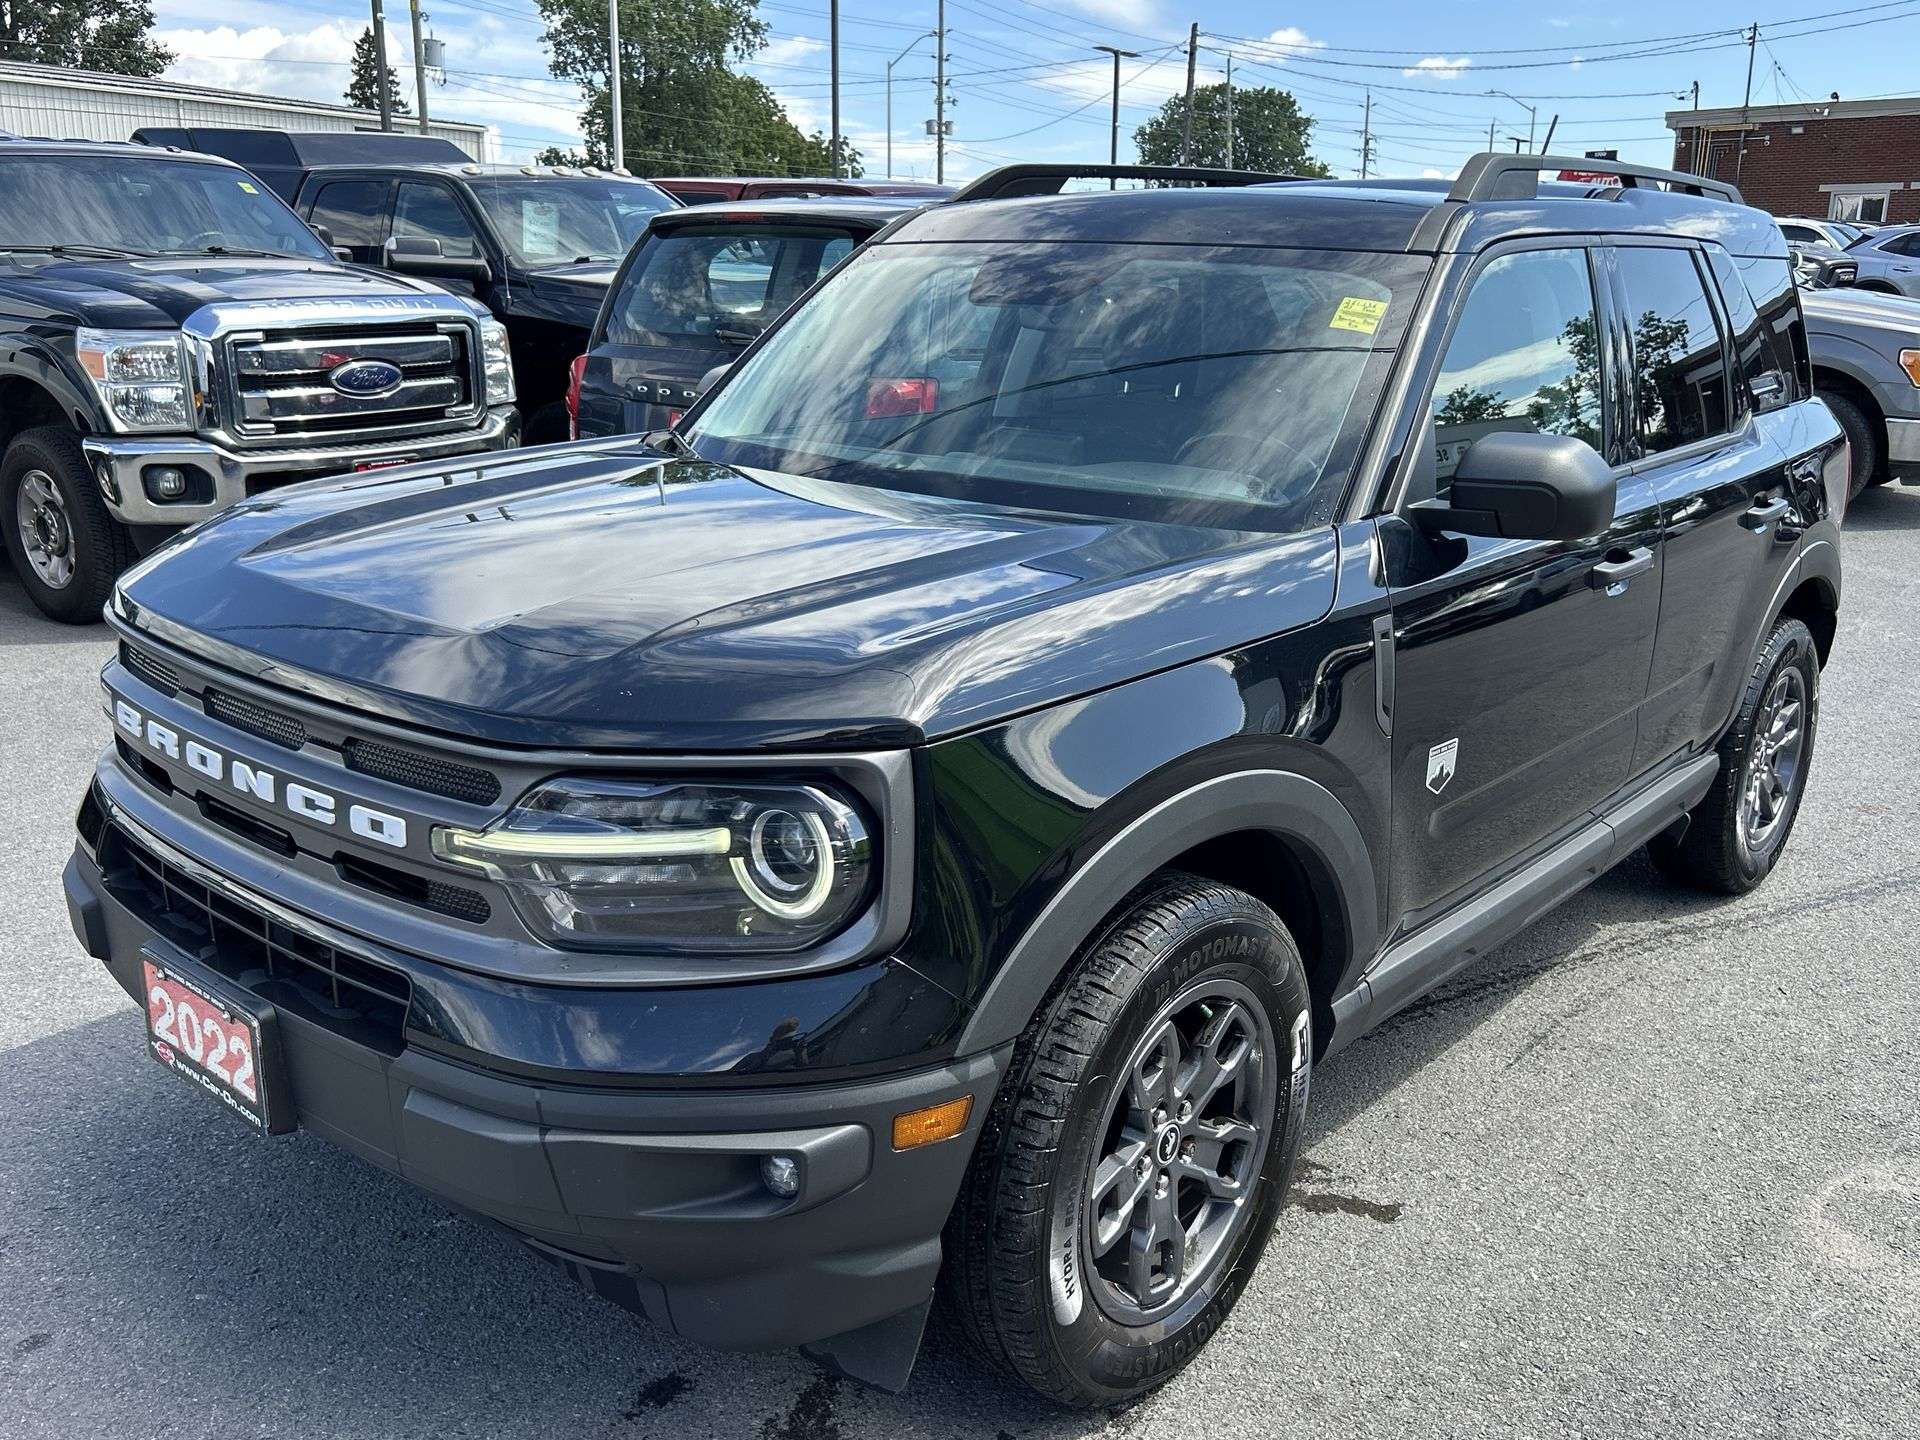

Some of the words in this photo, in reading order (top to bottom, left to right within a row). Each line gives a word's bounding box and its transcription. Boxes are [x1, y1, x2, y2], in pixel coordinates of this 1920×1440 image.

[352, 367, 389, 386] Ford
[113, 698, 408, 849] BRONCO
[1173, 935, 1283, 981] MOTOMASTER
[150, 986, 257, 1105] 2022
[176, 1059, 262, 1128] www.Car-On.com
[1062, 1235, 1075, 1301] HYDRA
